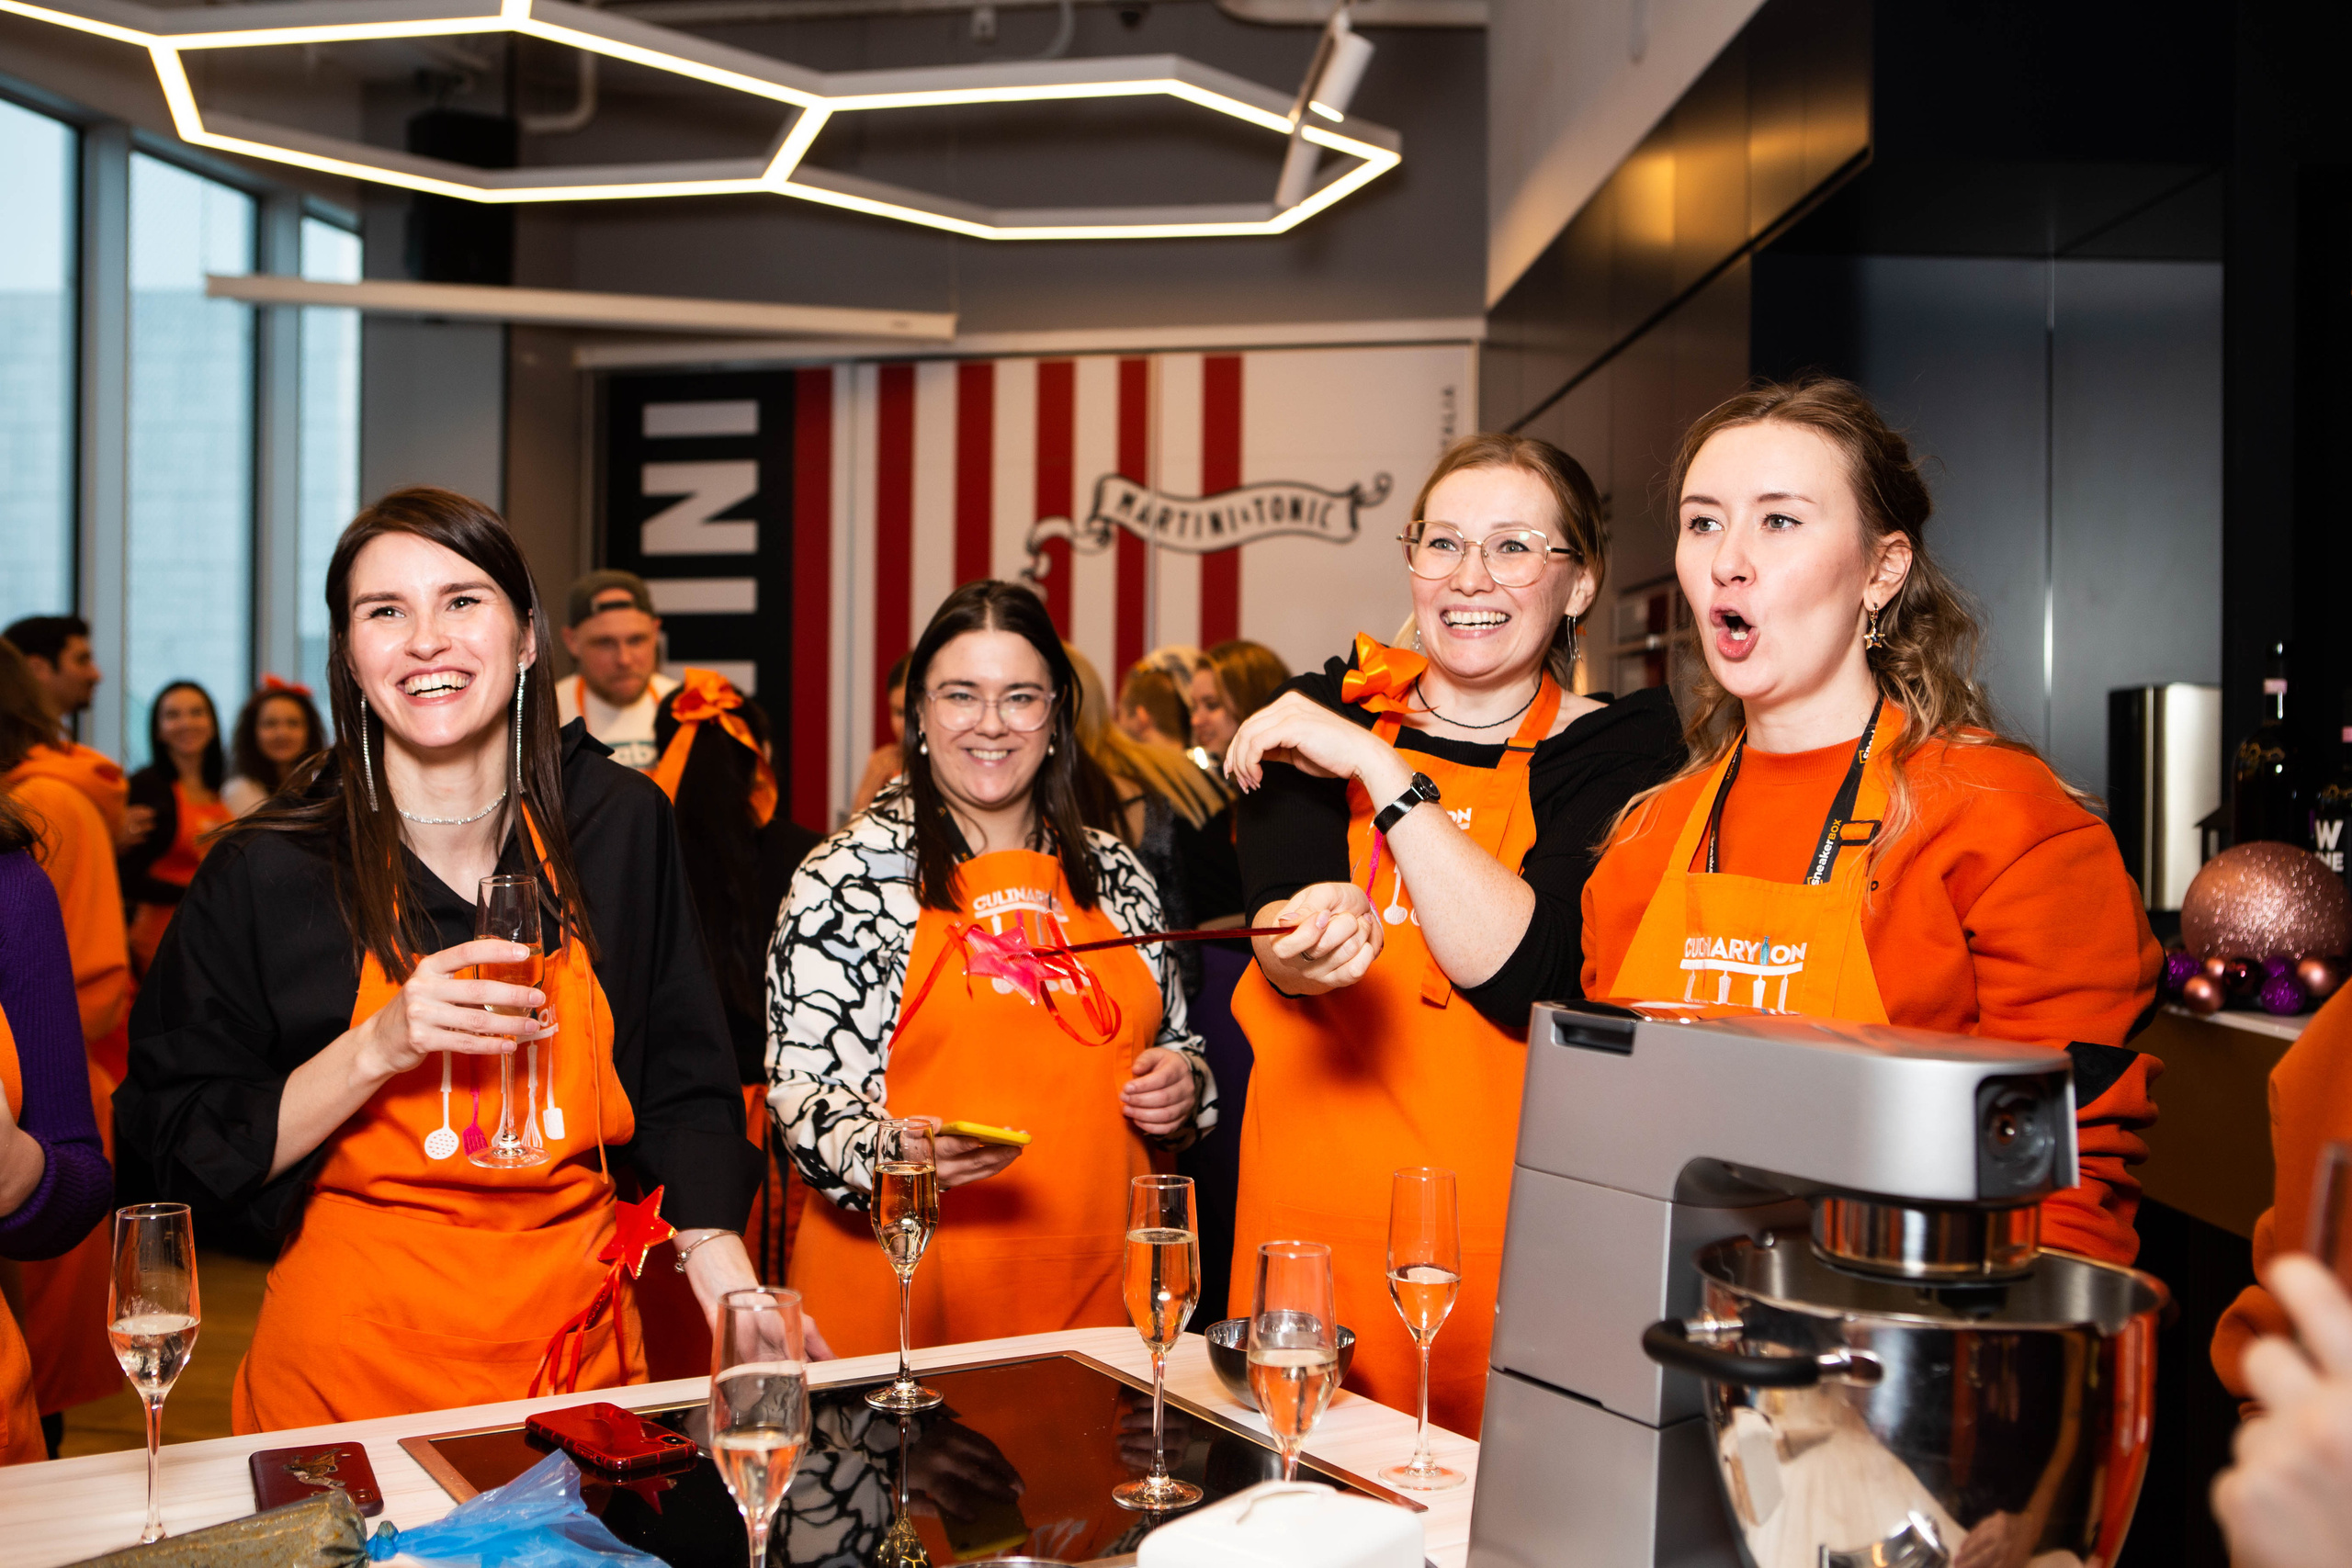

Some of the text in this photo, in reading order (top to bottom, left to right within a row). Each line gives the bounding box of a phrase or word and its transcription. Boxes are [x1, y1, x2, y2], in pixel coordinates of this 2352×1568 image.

[1118, 491, 1238, 538] MARTINI
[1252, 494, 1334, 530] TONIC
[1810, 818, 1842, 886] sneakerBOX
